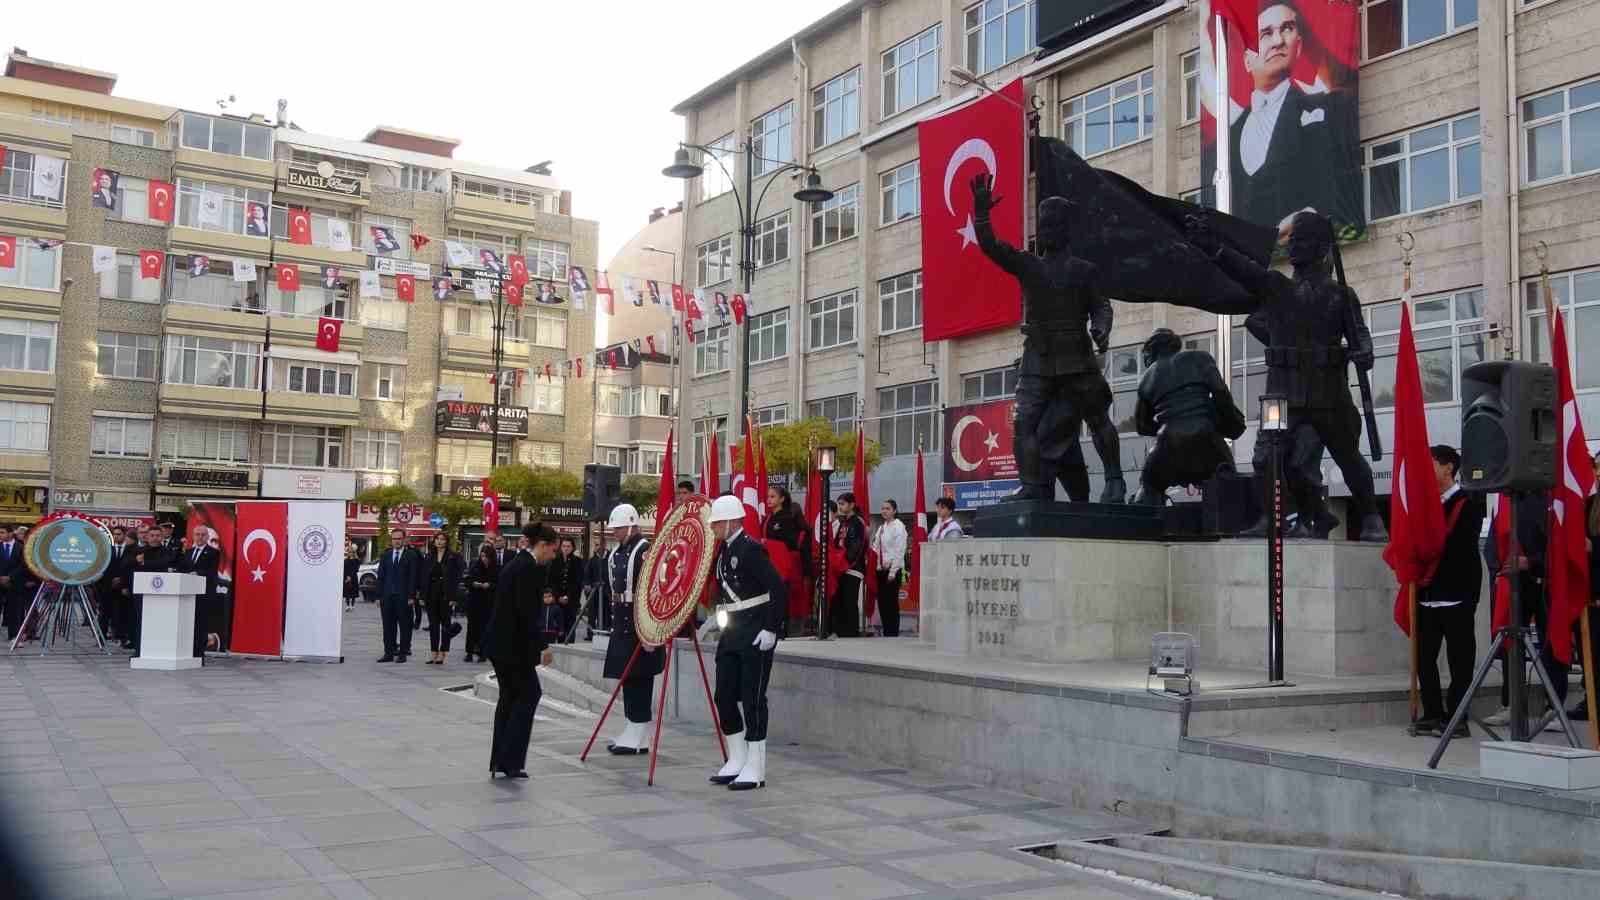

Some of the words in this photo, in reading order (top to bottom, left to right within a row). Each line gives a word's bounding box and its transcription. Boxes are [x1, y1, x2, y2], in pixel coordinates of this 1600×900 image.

[289, 172, 327, 189] EMEL
[447, 403, 480, 416] TALAY
[955, 554, 974, 567] NE
[979, 554, 1030, 567] MUTLU
